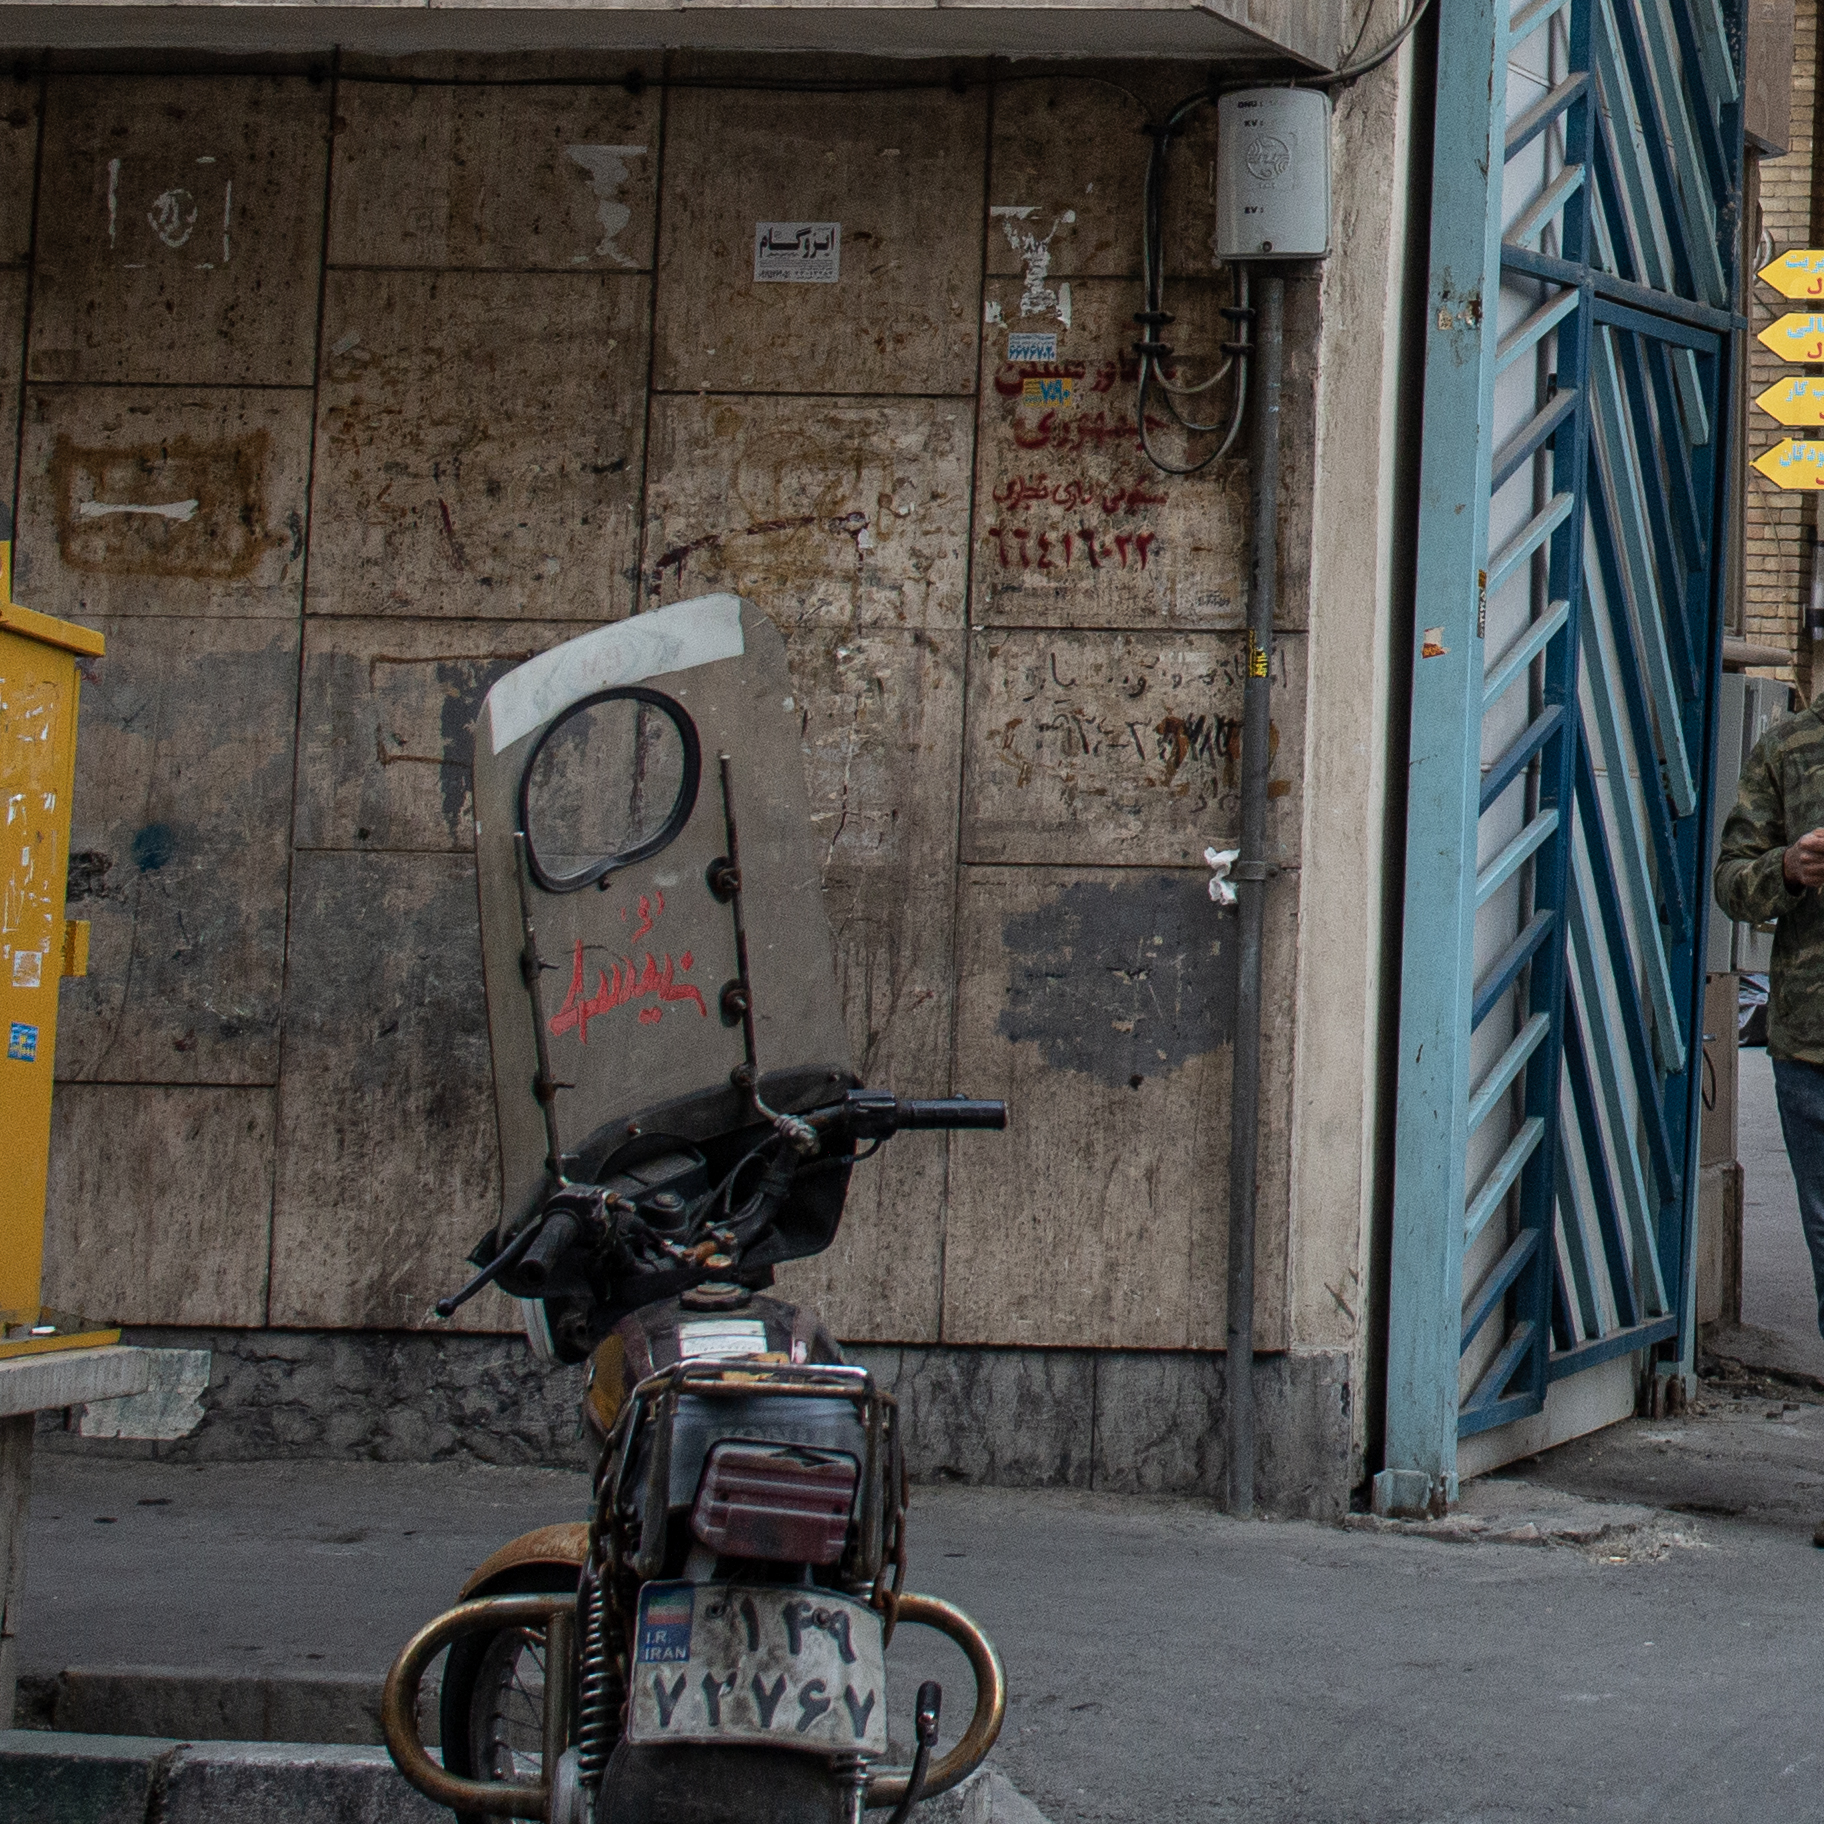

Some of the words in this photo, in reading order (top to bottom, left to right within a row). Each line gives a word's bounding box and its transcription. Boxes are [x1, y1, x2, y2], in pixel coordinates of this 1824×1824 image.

[759, 226, 836, 259] ایزوگام
[1785, 380, 1809, 402] کار
[645, 1645, 687, 1661] IRAN
[653, 1670, 876, 1740] ۷۲۷۶۷
